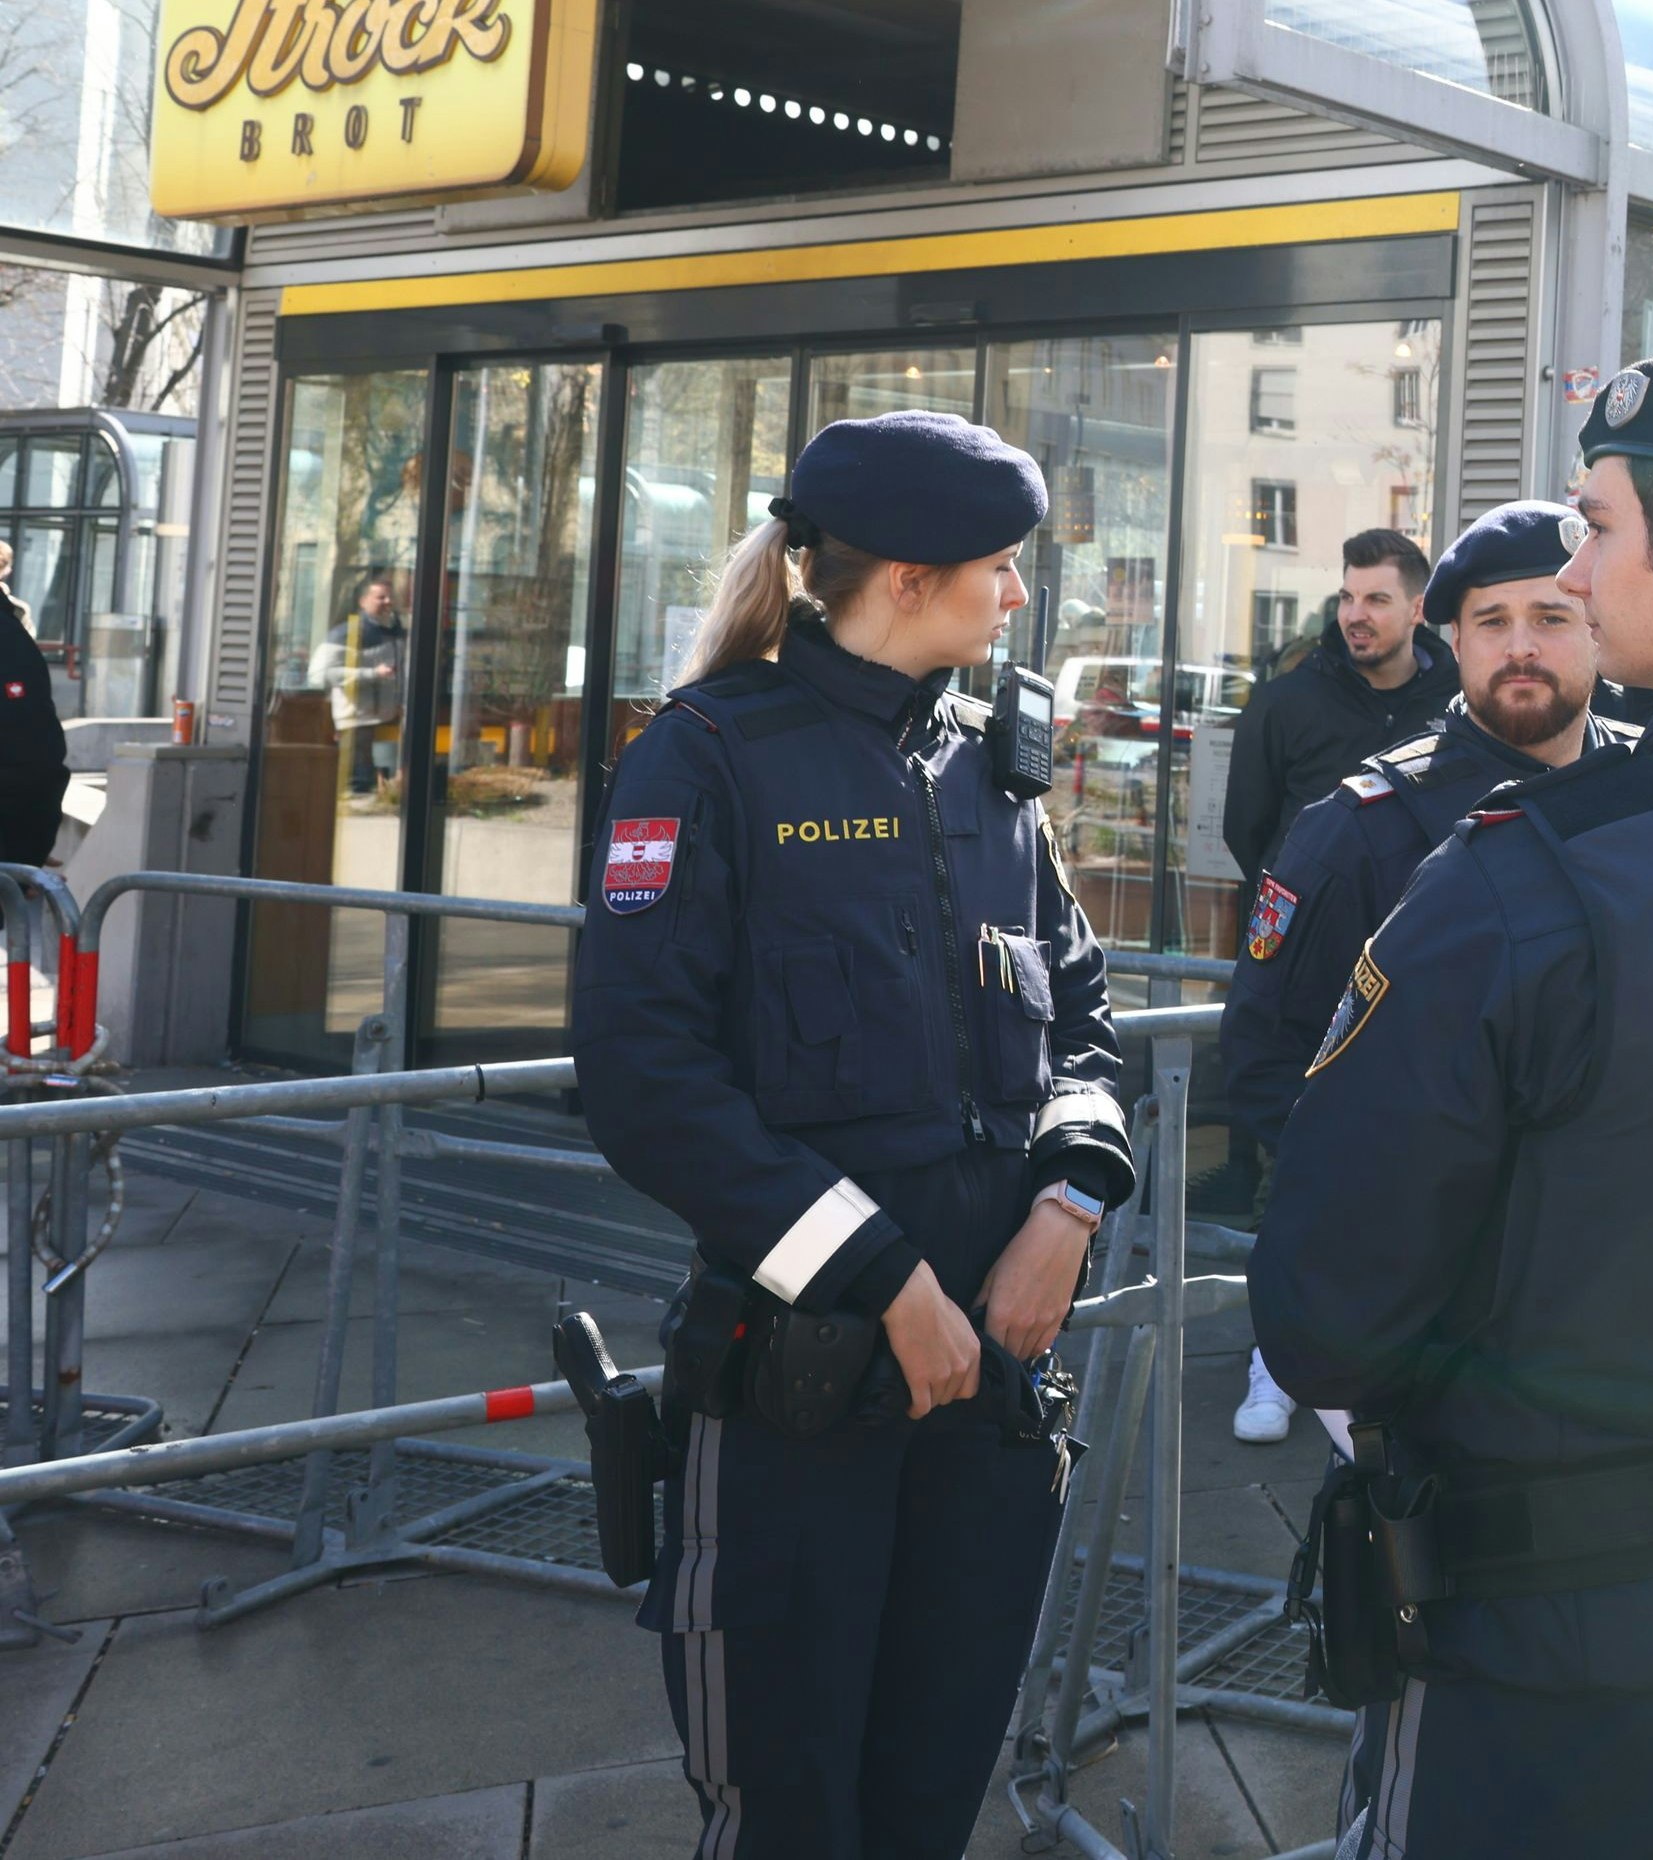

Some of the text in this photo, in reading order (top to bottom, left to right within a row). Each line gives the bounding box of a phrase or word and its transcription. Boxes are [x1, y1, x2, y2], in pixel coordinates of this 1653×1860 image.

[239, 97, 423, 163] BROT
[777, 817, 900, 845] POLIZEI
[609, 890, 656, 903] POLIZEI
